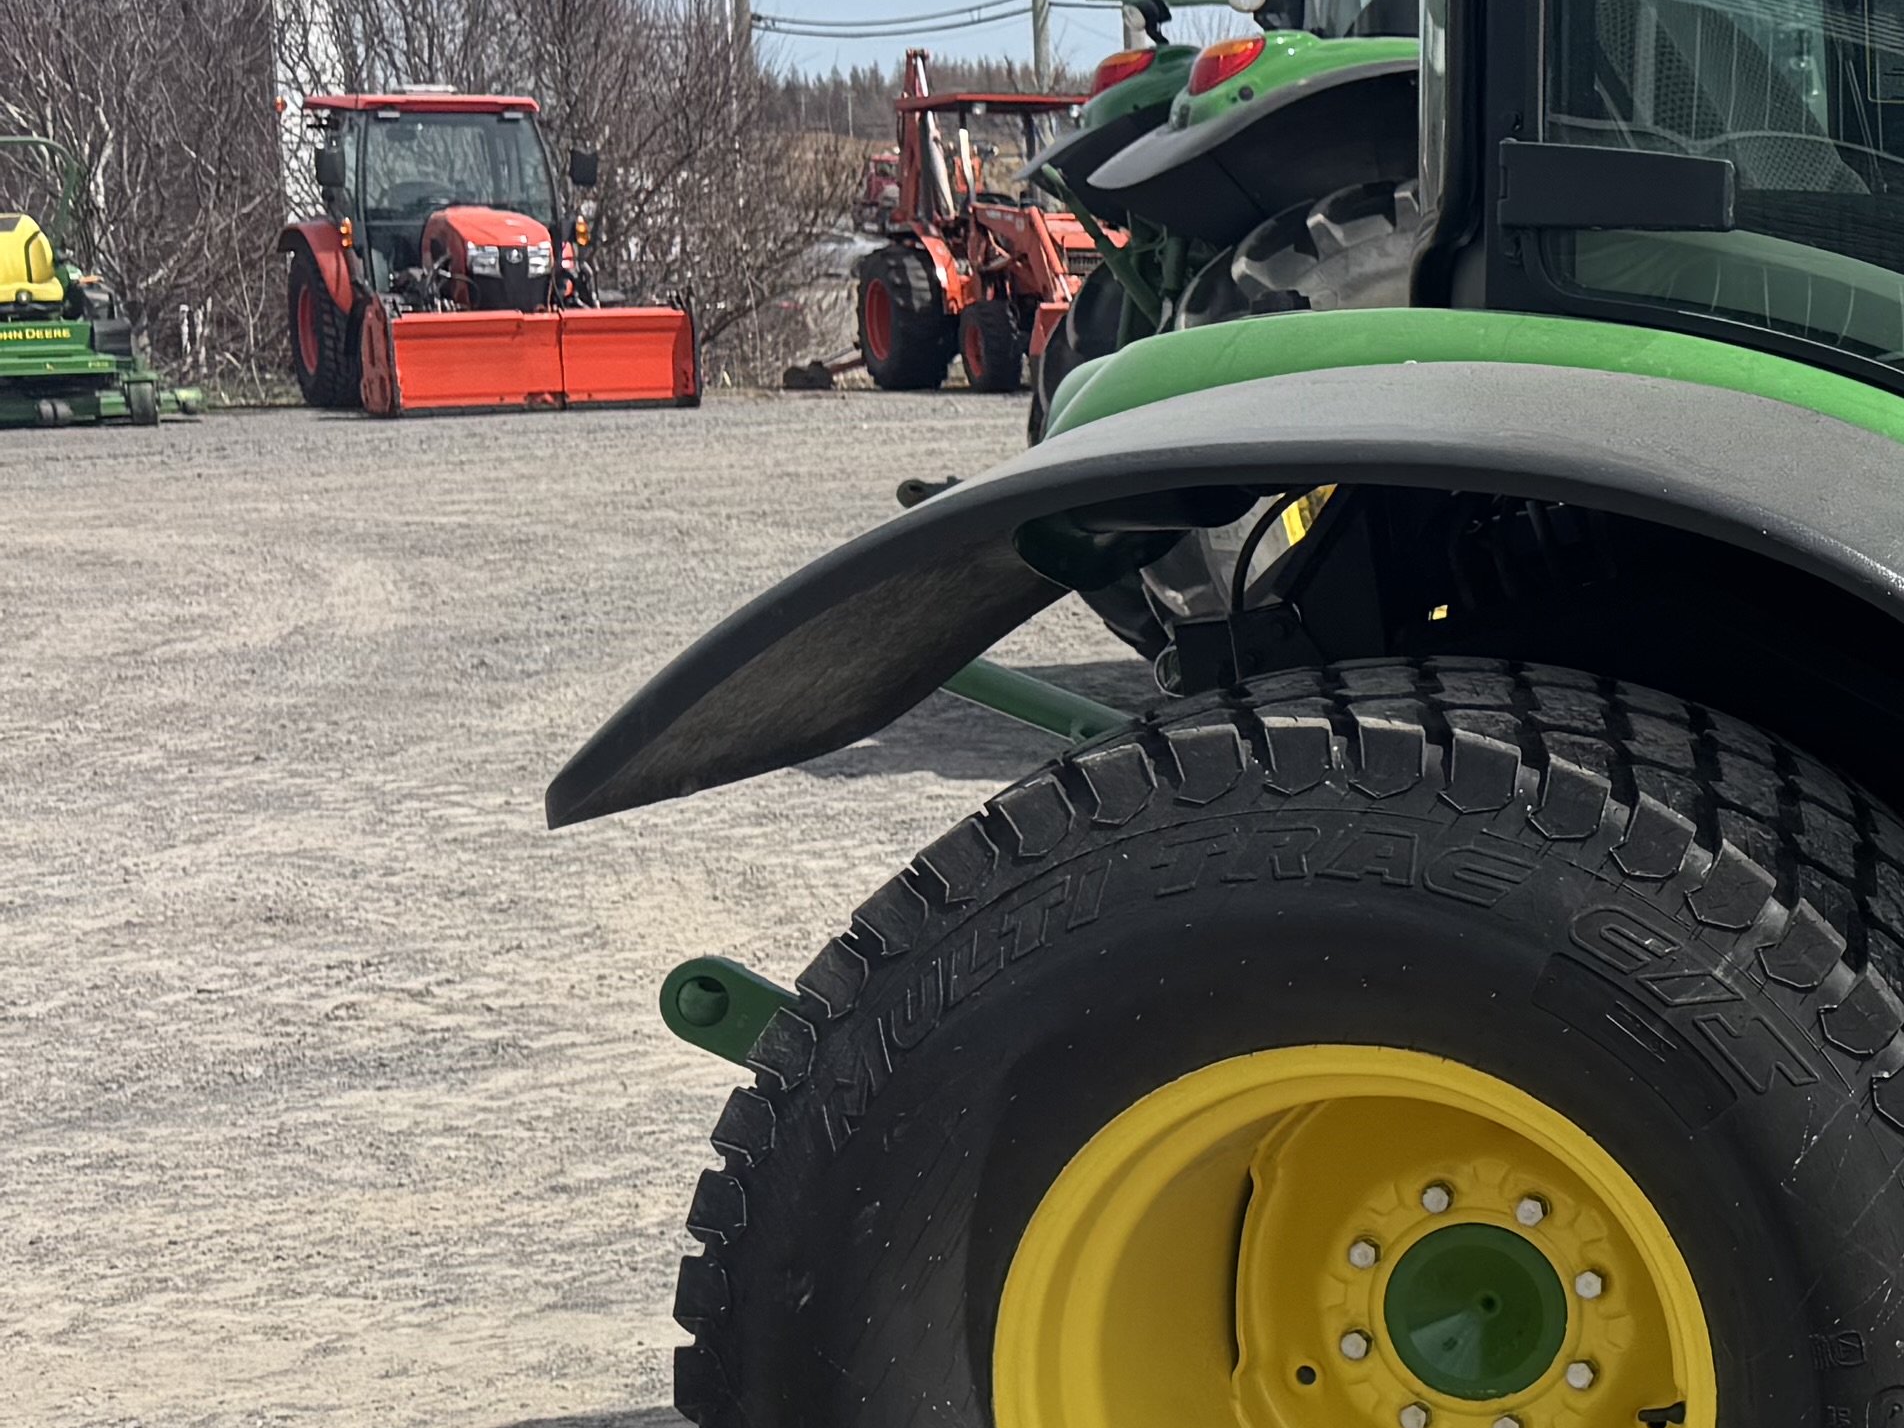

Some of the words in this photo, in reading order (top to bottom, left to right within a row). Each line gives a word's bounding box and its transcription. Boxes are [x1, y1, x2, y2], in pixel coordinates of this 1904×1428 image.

[0, 329, 23, 340] HN
[25, 328, 71, 339] DEERE
[819, 859, 1114, 1154] MULTI
